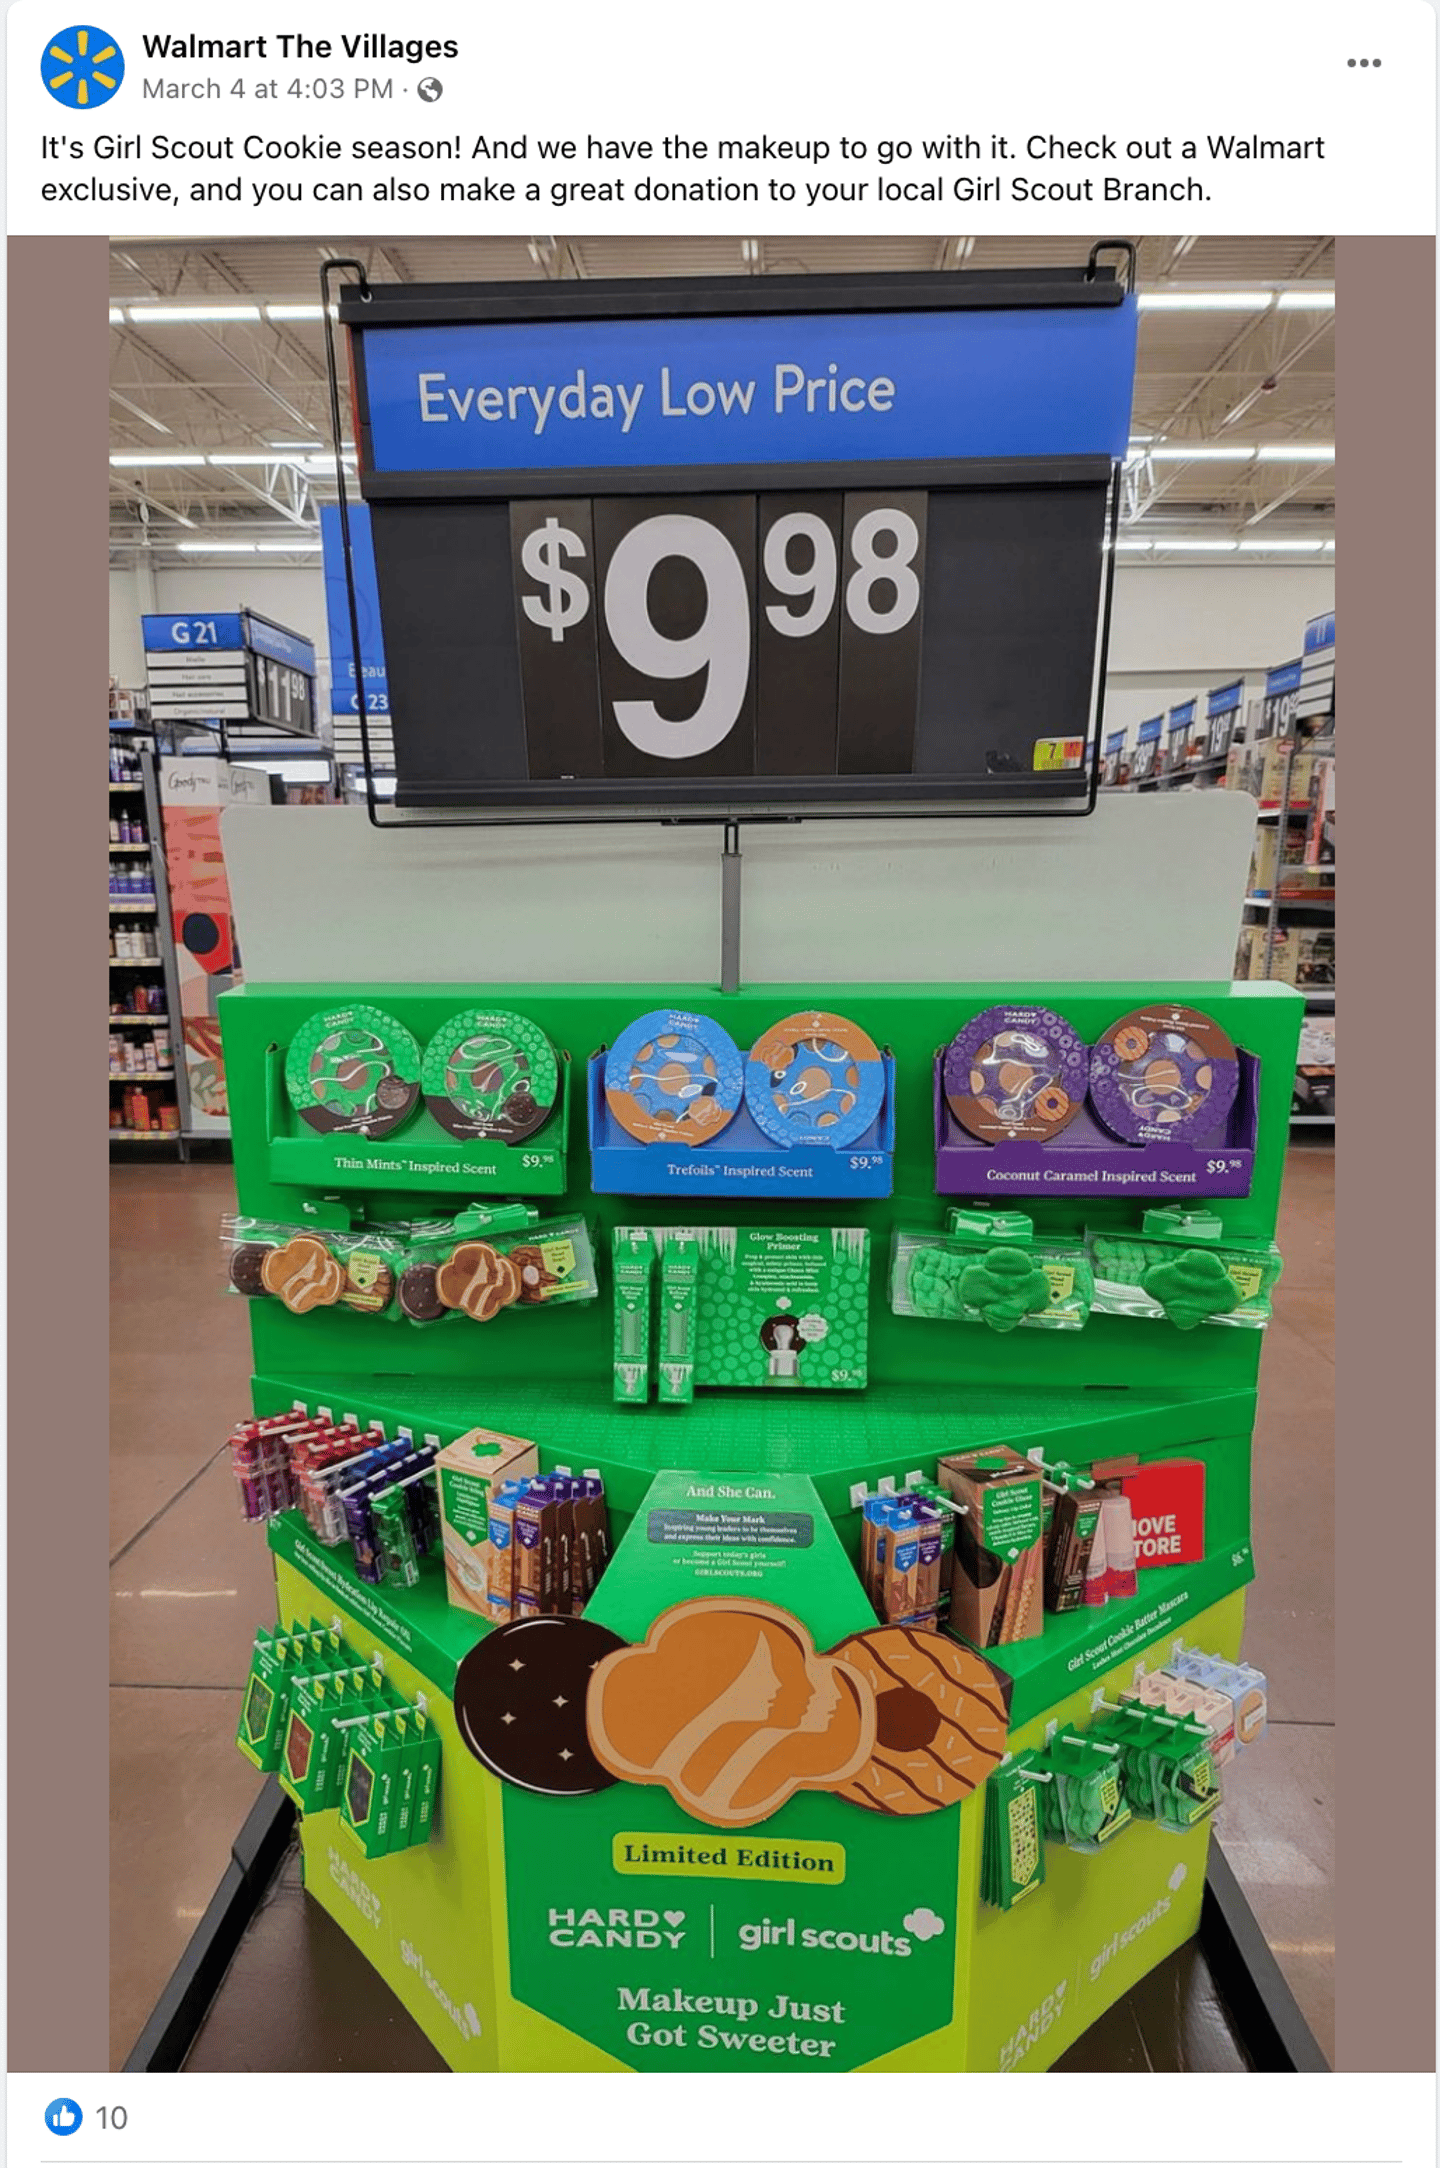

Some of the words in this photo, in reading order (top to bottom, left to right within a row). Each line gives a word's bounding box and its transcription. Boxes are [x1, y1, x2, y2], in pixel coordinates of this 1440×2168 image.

[418, 368, 644, 434] Everyday
[661, 367, 756, 418] Low
[774, 362, 896, 415] Price
[171, 621, 190, 644] G
[192, 621, 218, 644] 21
[334, 1157, 364, 1169] Thin
[408, 1160, 461, 1176] Inspired
[462, 1163, 497, 1176] Scent
[723, 1165, 777, 1179] Inspired
[778, 1166, 814, 1178] Scent
[1206, 1158, 1242, 1174] $9.98
[986, 1170, 1040, 1182] Coconut
[1043, 1170, 1099, 1182] Caramel
[1101, 1170, 1157, 1185] Inspired
[1159, 1171, 1197, 1183] Scent
[749, 1232, 774, 1242] Glow
[775, 1233, 819, 1243] Boosting
[766, 1242, 801, 1251] Primer
[686, 1485, 714, 1498] And
[718, 1486, 743, 1499] She
[745, 1486, 776, 1500] Can.
[695, 1513, 720, 1523] Make
[720, 1514, 742, 1524] Your
[742, 1515, 766, 1524] Mark
[663, 1523, 695, 1533] Inspiring
[696, 1525, 716, 1533] young
[749, 1525, 759, 1534] be
[759, 1526, 798, 1535] themselves
[663, 1533, 677, 1541] and
[677, 1534, 704, 1543] express
[740, 1534, 757, 1543] with
[692, 1550, 722, 1560] Support
[717, 1558, 732, 1567] Girl
[694, 1569, 764, 1578] GIRLSCOUTS.ORG
[1067, 1653, 1085, 1672] Girl
[1084, 1639, 1108, 1662] Scout
[1107, 1624, 1134, 1647] Cookie
[1158, 1591, 1189, 1616] Mascara
[624, 1844, 728, 1867] Limited
[736, 1848, 835, 1873] Edition
[548, 1908, 661, 1928] HARD
[548, 1930, 687, 1950] CANDY
[738, 1917, 795, 1951] girl
[801, 1928, 913, 1957] scouts
[1088, 1930, 1119, 1982] girl
[1119, 1896, 1173, 1952] scouts
[616, 1987, 759, 2021] Makeup
[767, 1994, 846, 2024] Just
[626, 2021, 688, 2048] Got
[697, 2024, 836, 2058] Sweeter
